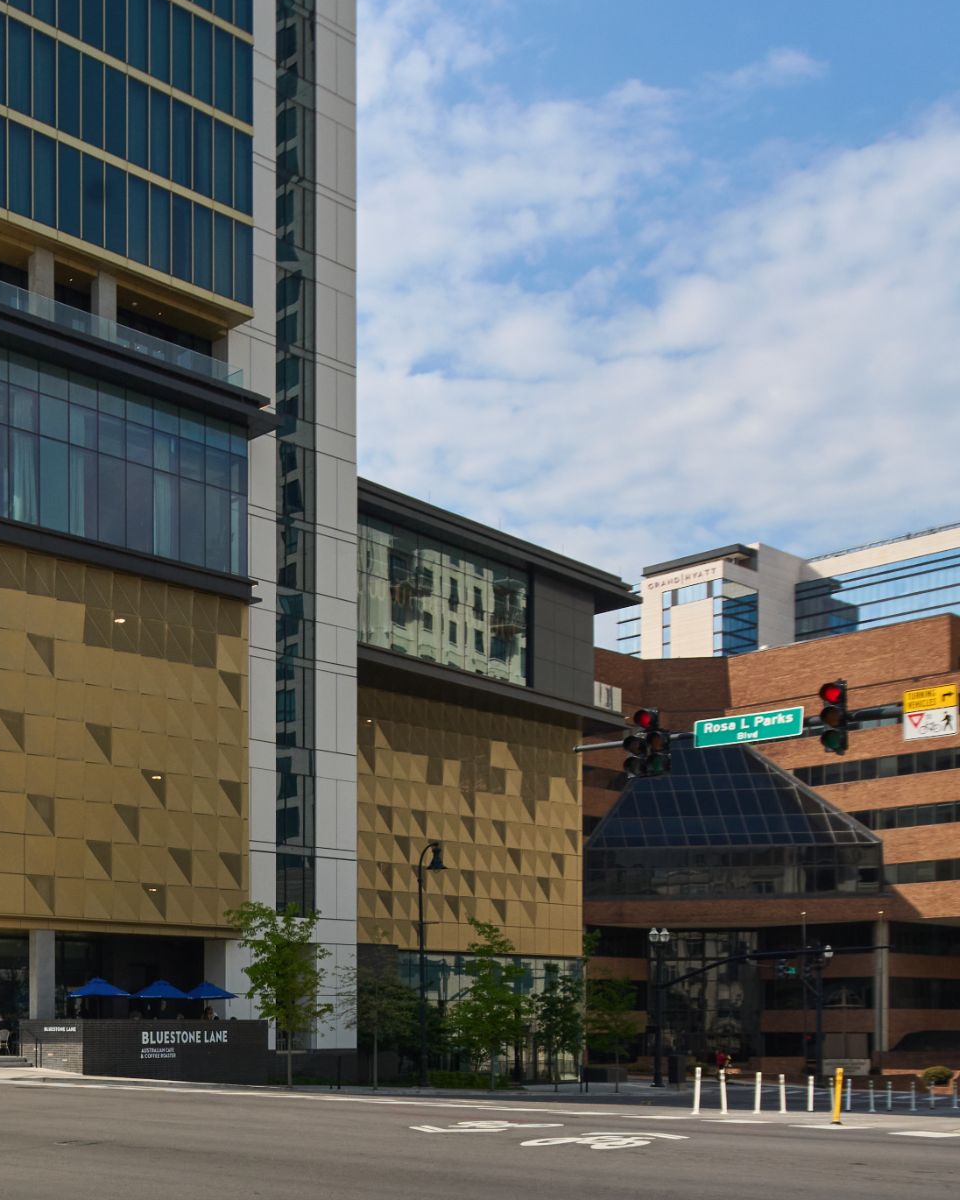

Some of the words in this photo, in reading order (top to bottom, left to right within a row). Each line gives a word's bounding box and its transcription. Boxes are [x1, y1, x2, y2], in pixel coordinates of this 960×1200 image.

[647, 576, 680, 590] GRAND
[685, 567, 717, 580] HYATT
[704, 722, 736, 733] Rosa
[740, 718, 750, 729] L
[754, 713, 794, 727] Parks
[737, 731, 758, 740] Blvd
[142, 1031, 201, 1044] BLUESTONE
[204, 1030, 228, 1043] LANE
